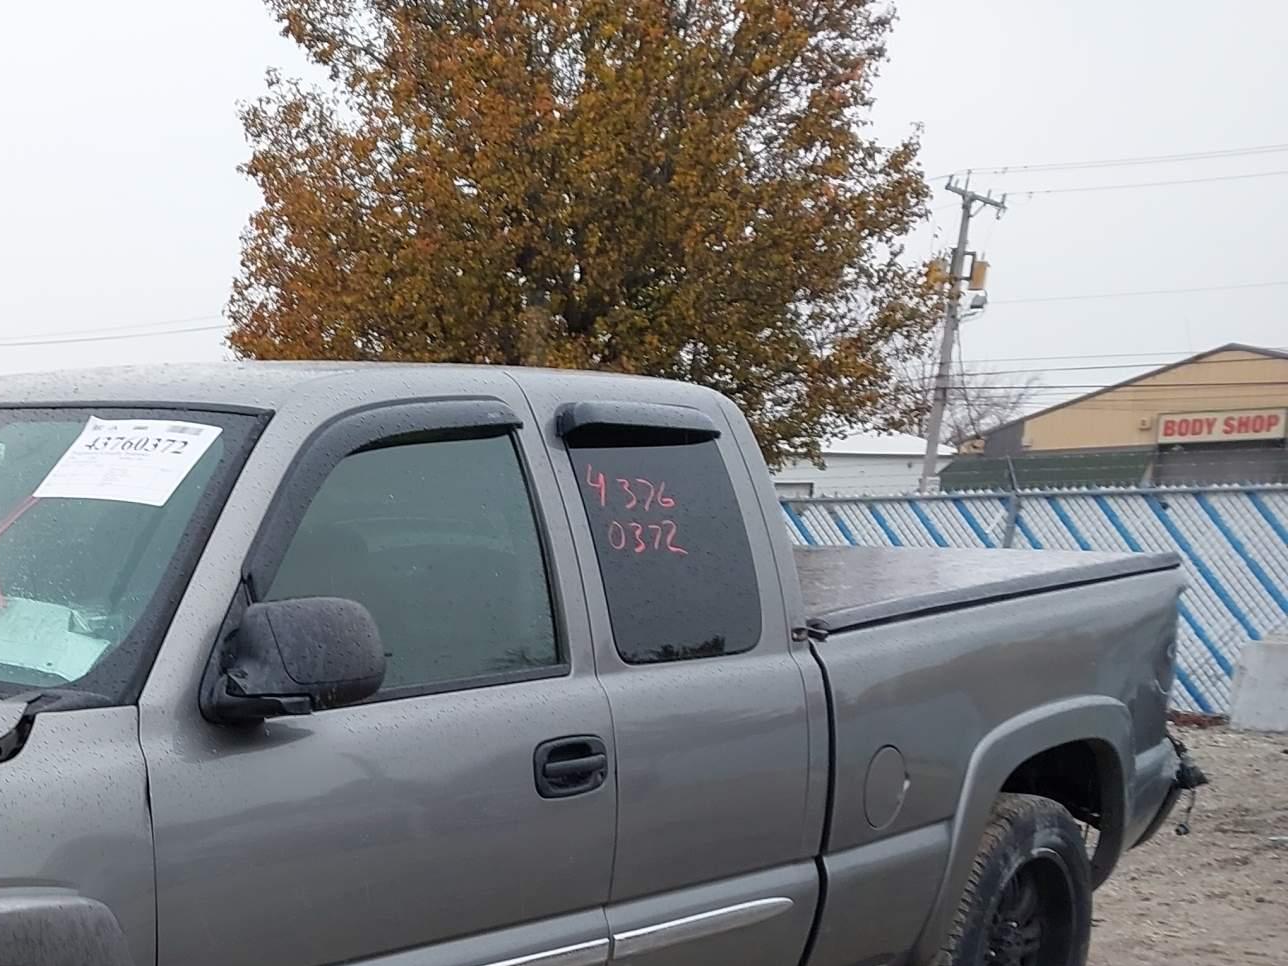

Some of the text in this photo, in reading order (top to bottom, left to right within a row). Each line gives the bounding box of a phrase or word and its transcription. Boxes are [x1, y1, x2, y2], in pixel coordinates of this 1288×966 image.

[1162, 414, 1280, 438] BODY SHOP
[85, 436, 188, 454] 43760372
[586, 464, 676, 511] 4376
[608, 520, 689, 555] 0372
